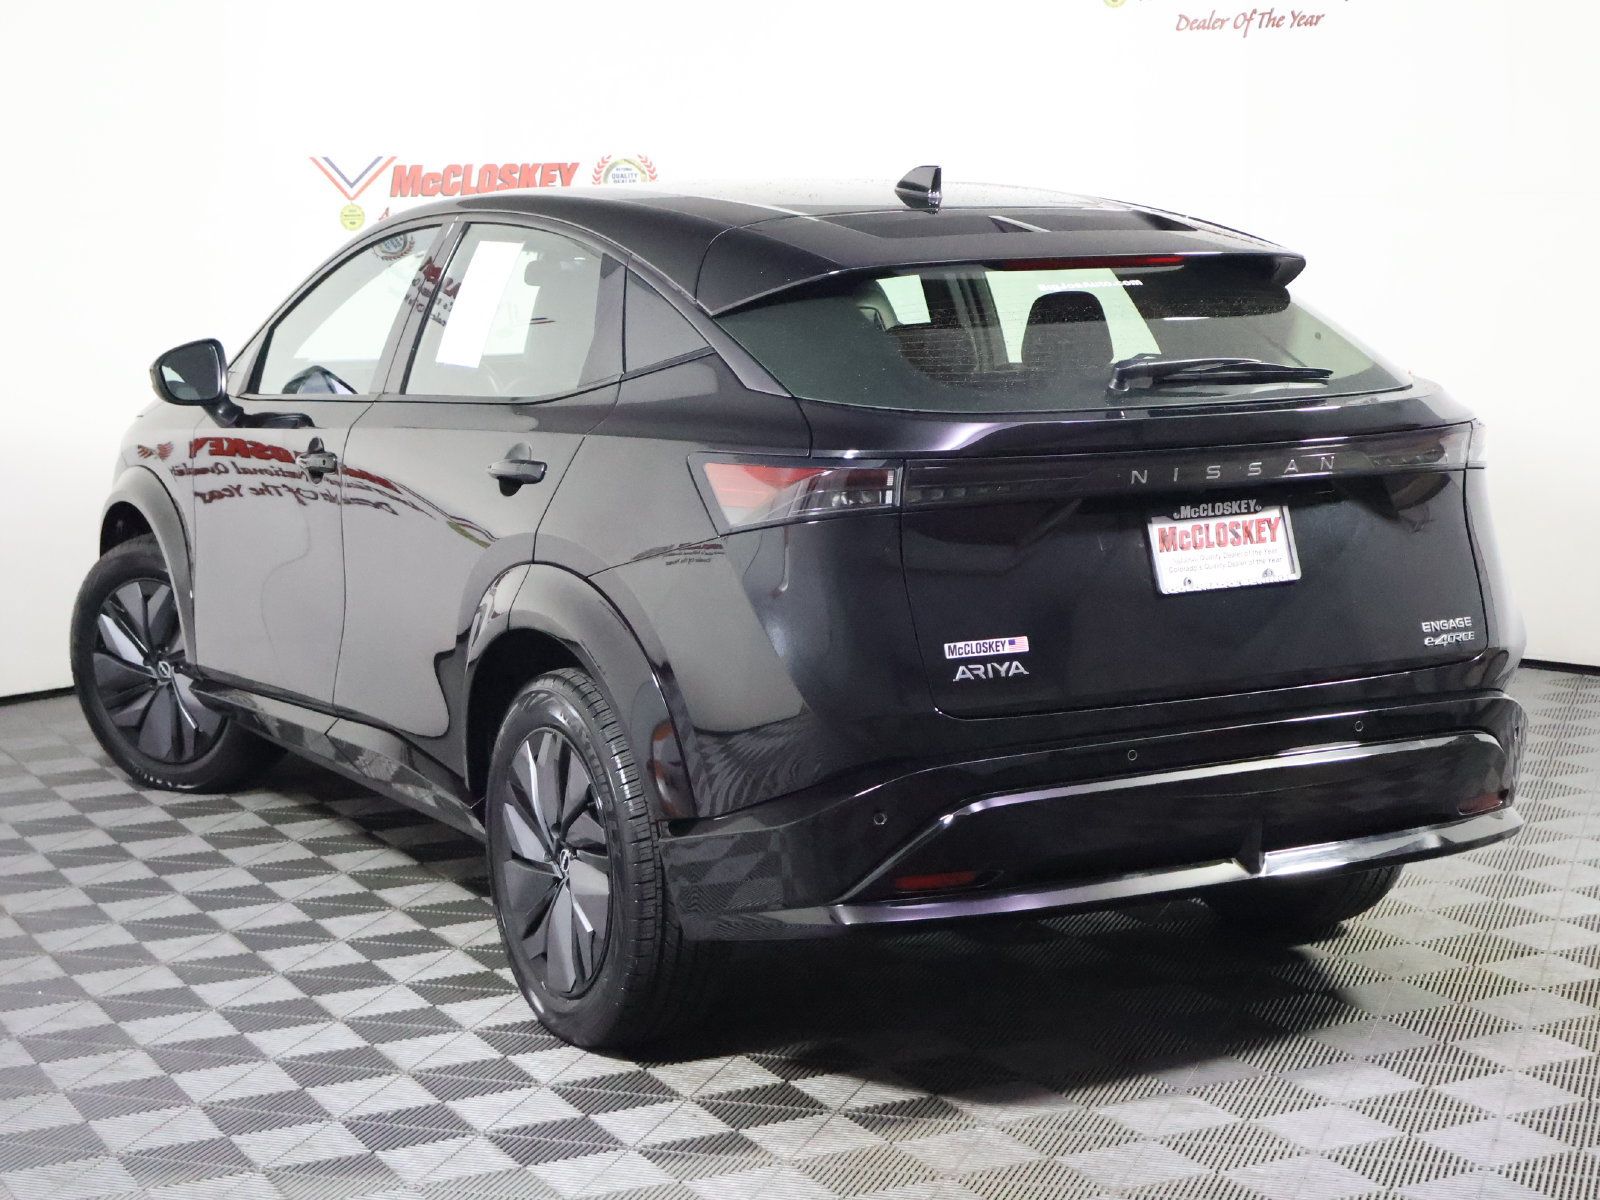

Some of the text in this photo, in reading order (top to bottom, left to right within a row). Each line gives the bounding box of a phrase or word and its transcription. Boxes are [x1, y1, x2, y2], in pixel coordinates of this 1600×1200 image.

[1175, 8, 1325, 38] Dealer Of The Year
[390, 162, 580, 197] McCLOSKEY
[1131, 455, 1336, 485] NISSAN
[1179, 499, 1257, 519] McCLOSKEY
[1158, 516, 1282, 553] McCLOSKEY
[1421, 616, 1472, 633] ENGAGE
[947, 640, 1006, 657] McCLOSKEY
[952, 660, 1030, 682] ARIYA
